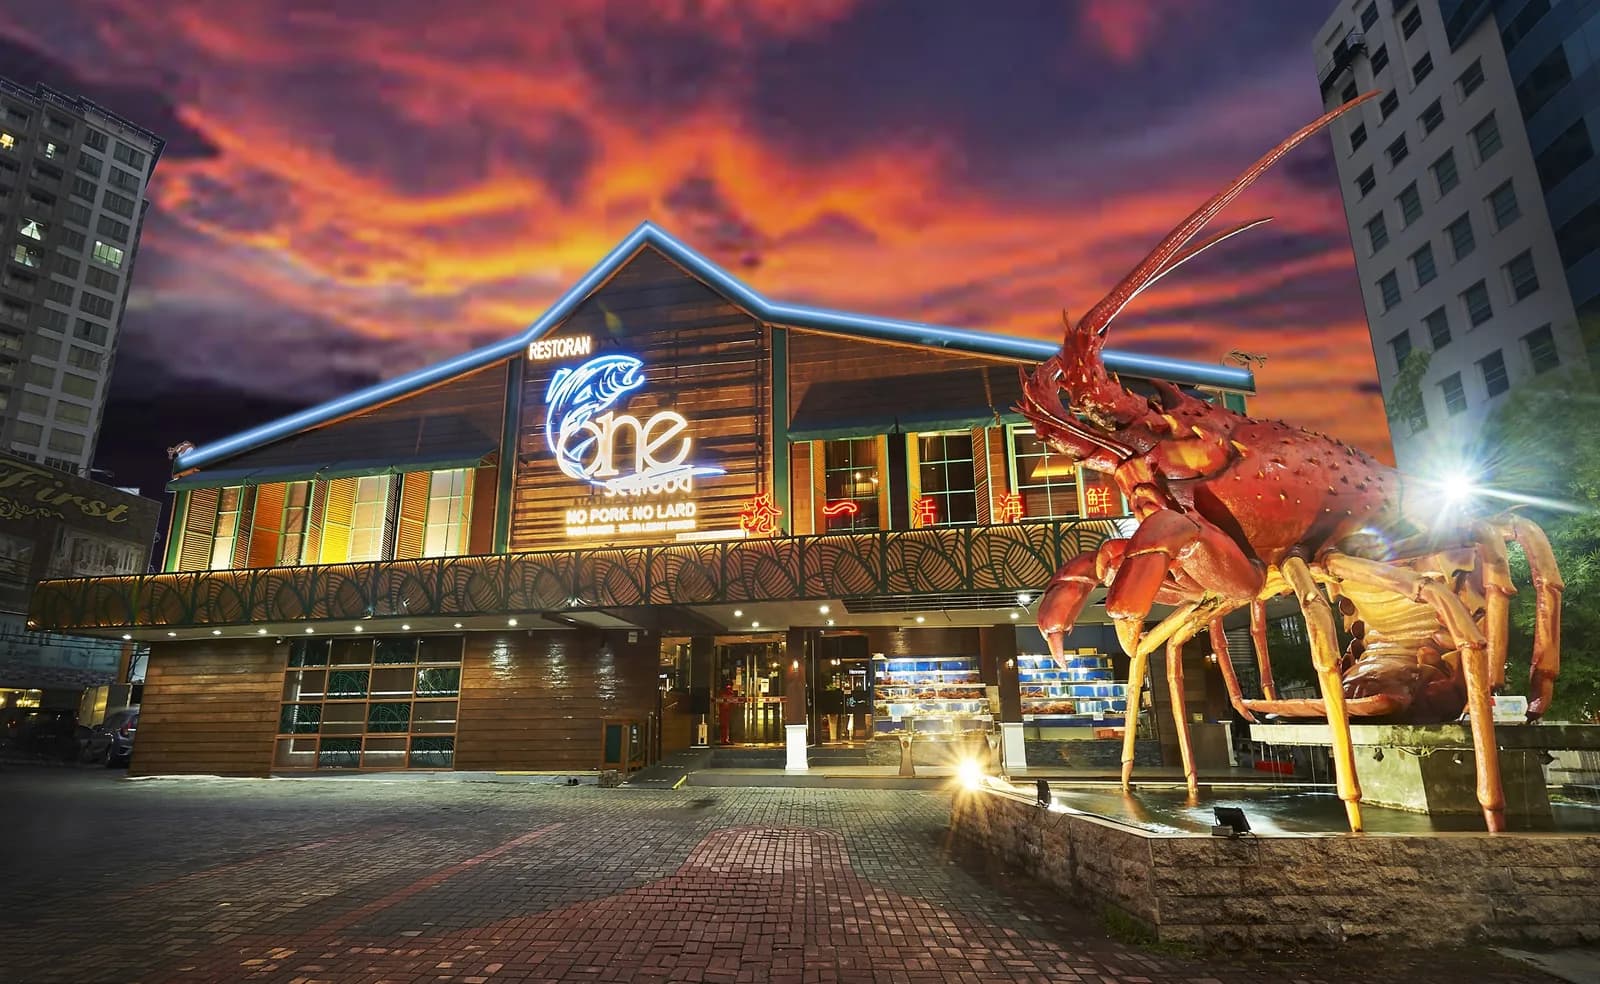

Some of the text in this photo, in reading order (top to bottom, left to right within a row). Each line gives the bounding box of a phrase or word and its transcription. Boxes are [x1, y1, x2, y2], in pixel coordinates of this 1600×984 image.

[529, 335, 591, 360] RESTORAN
[566, 502, 697, 525] NO PORK NO LARD
